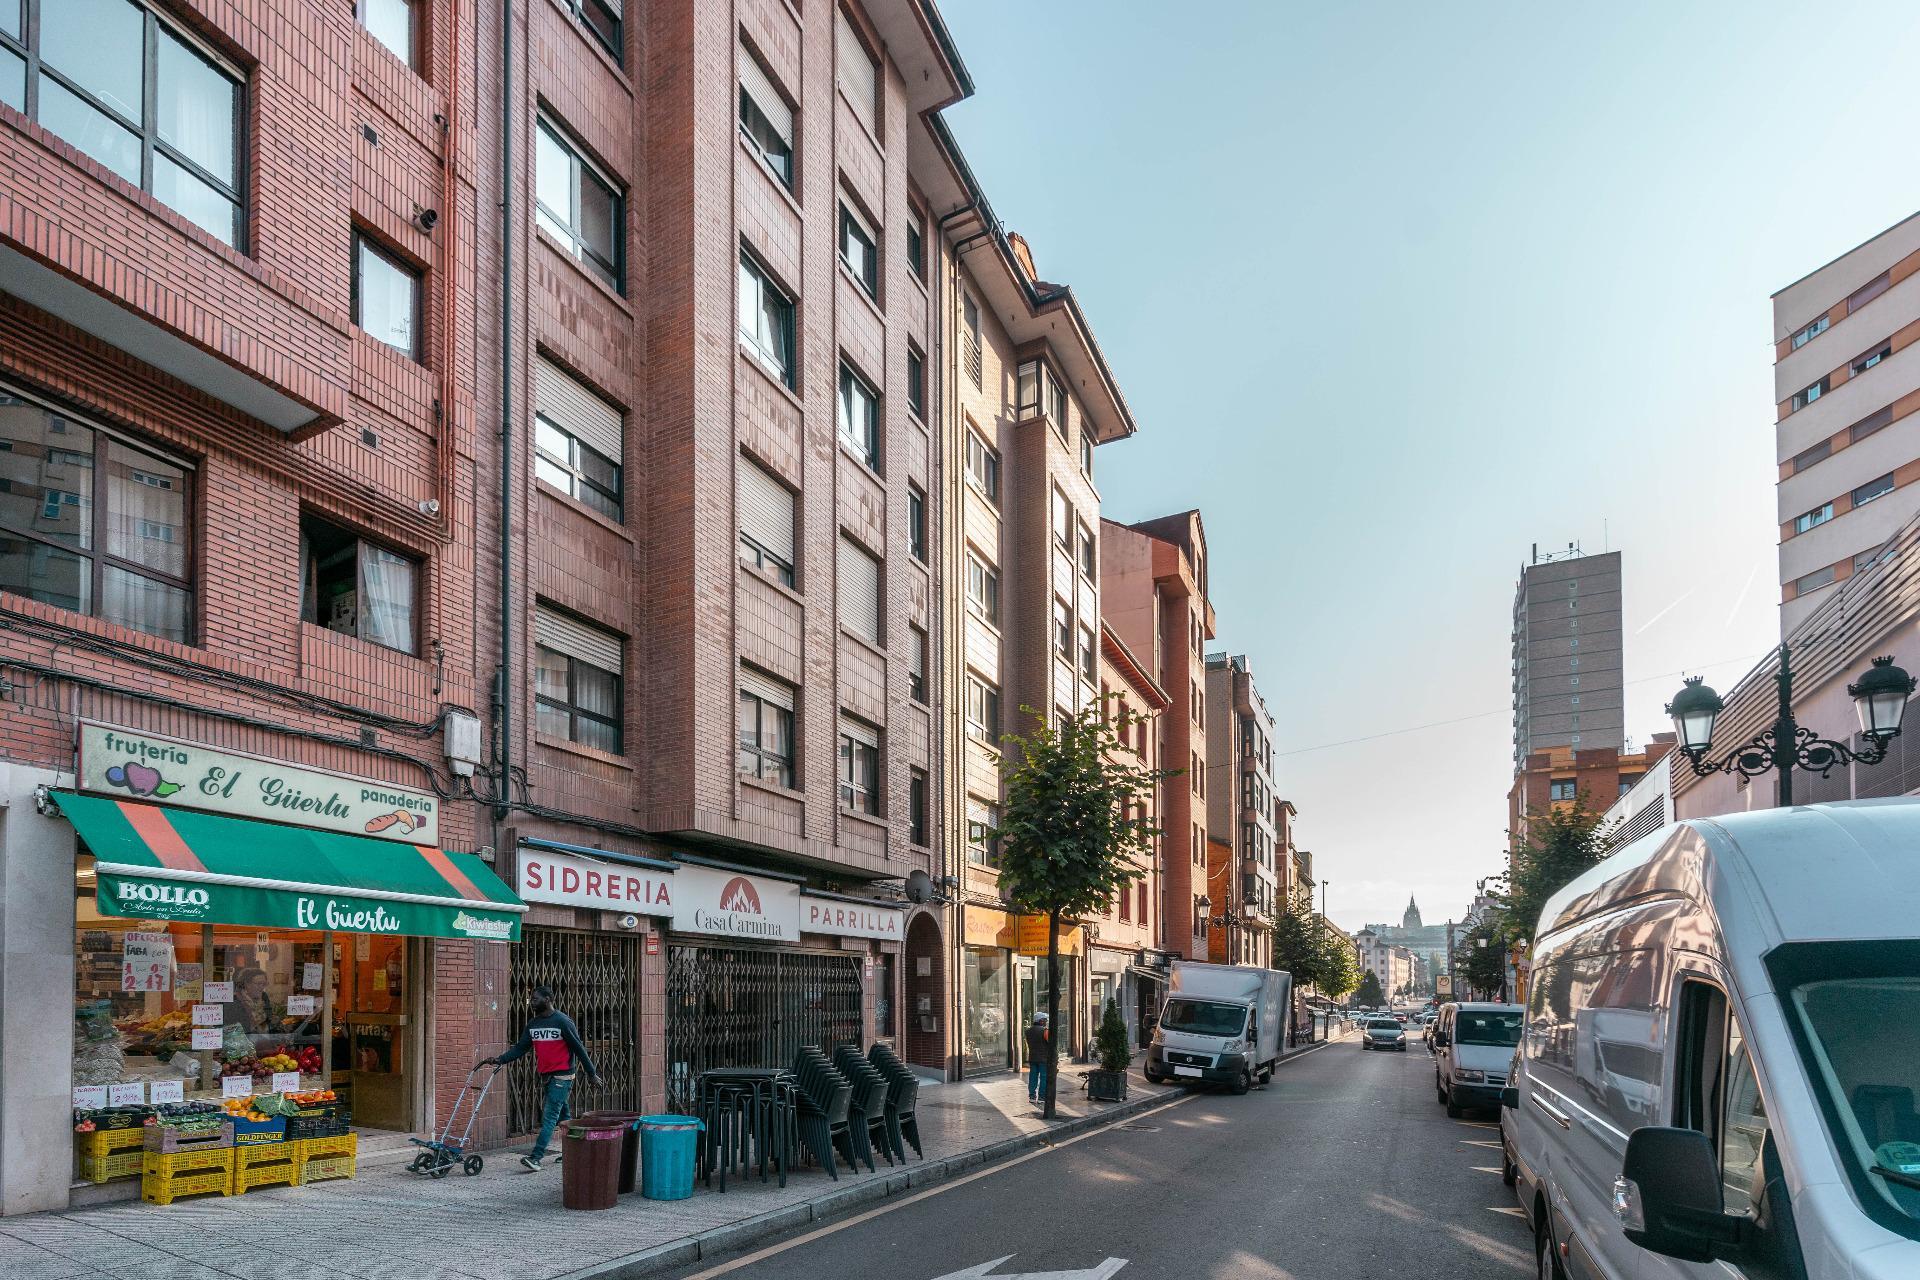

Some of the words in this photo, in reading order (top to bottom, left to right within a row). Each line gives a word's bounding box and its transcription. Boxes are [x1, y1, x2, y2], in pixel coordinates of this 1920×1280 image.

[105, 733, 188, 765] frutería
[199, 766, 242, 799] El
[259, 776, 350, 819] Güertu
[360, 788, 432, 813] panadería
[117, 882, 210, 906] BOLLO
[526, 861, 671, 906] SIDRERIA
[297, 897, 320, 928] El
[325, 900, 400, 932] Güertu
[694, 908, 726, 931] Casa
[728, 912, 782, 937] Carmina
[810, 905, 895, 933] PARRILLA
[126, 945, 148, 957] FABA
